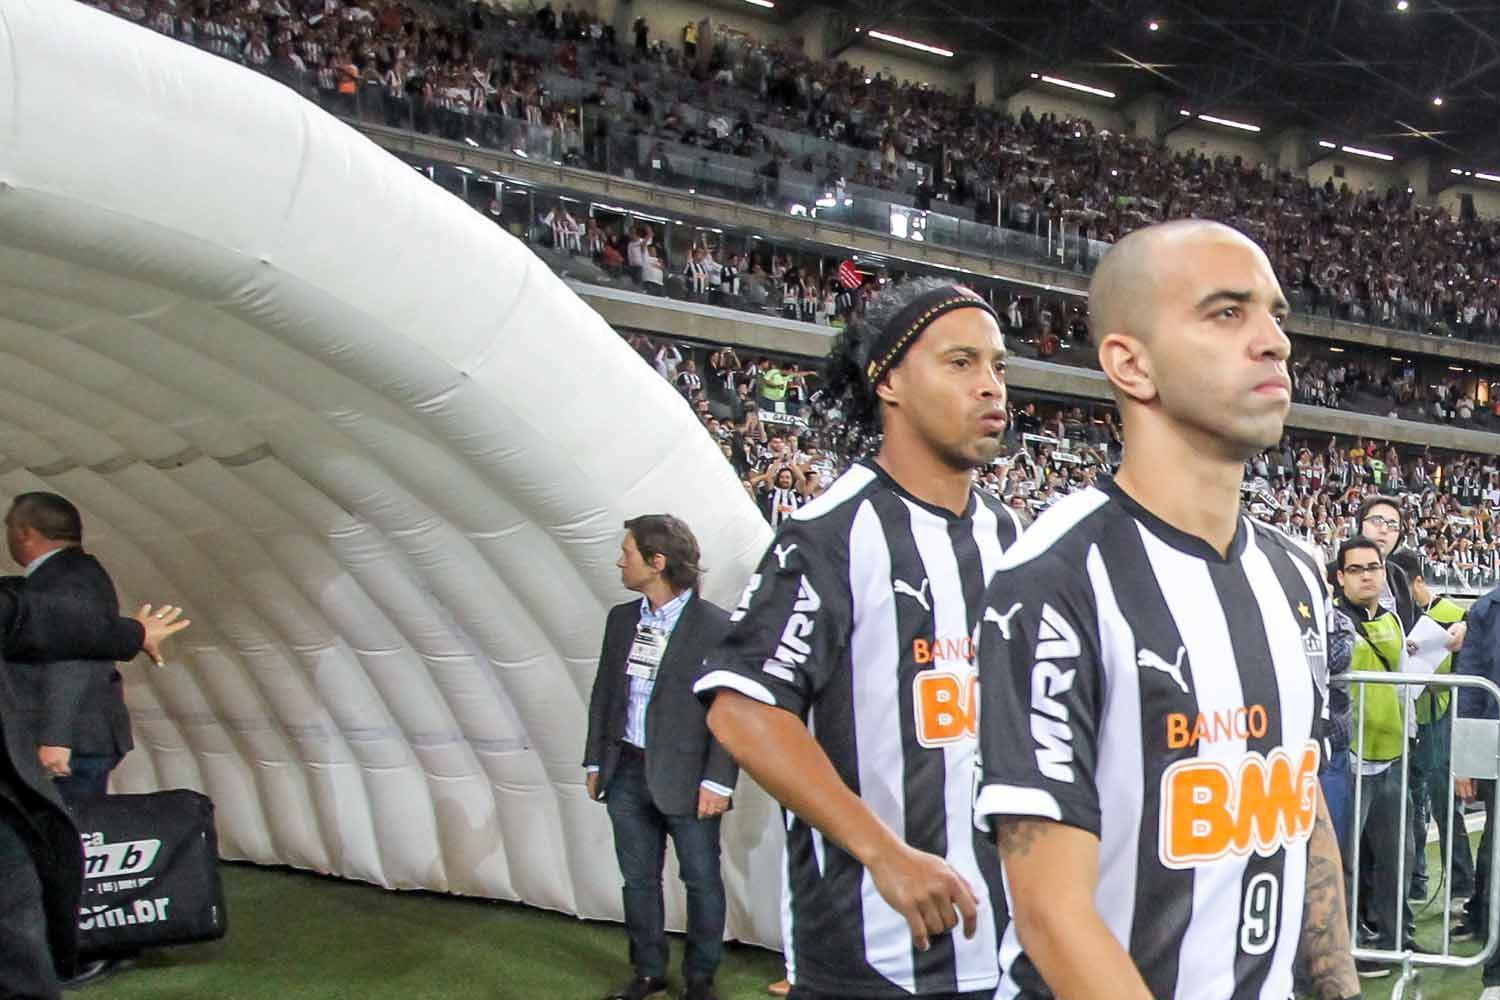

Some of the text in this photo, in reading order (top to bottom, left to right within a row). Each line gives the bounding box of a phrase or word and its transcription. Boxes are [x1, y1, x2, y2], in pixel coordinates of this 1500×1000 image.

[762, 574, 821, 682] MRV
[1030, 602, 1081, 783] MRV
[1166, 703, 1269, 750] BANCO
[1162, 742, 1320, 865] BMG
[1241, 872, 1280, 956] 9
